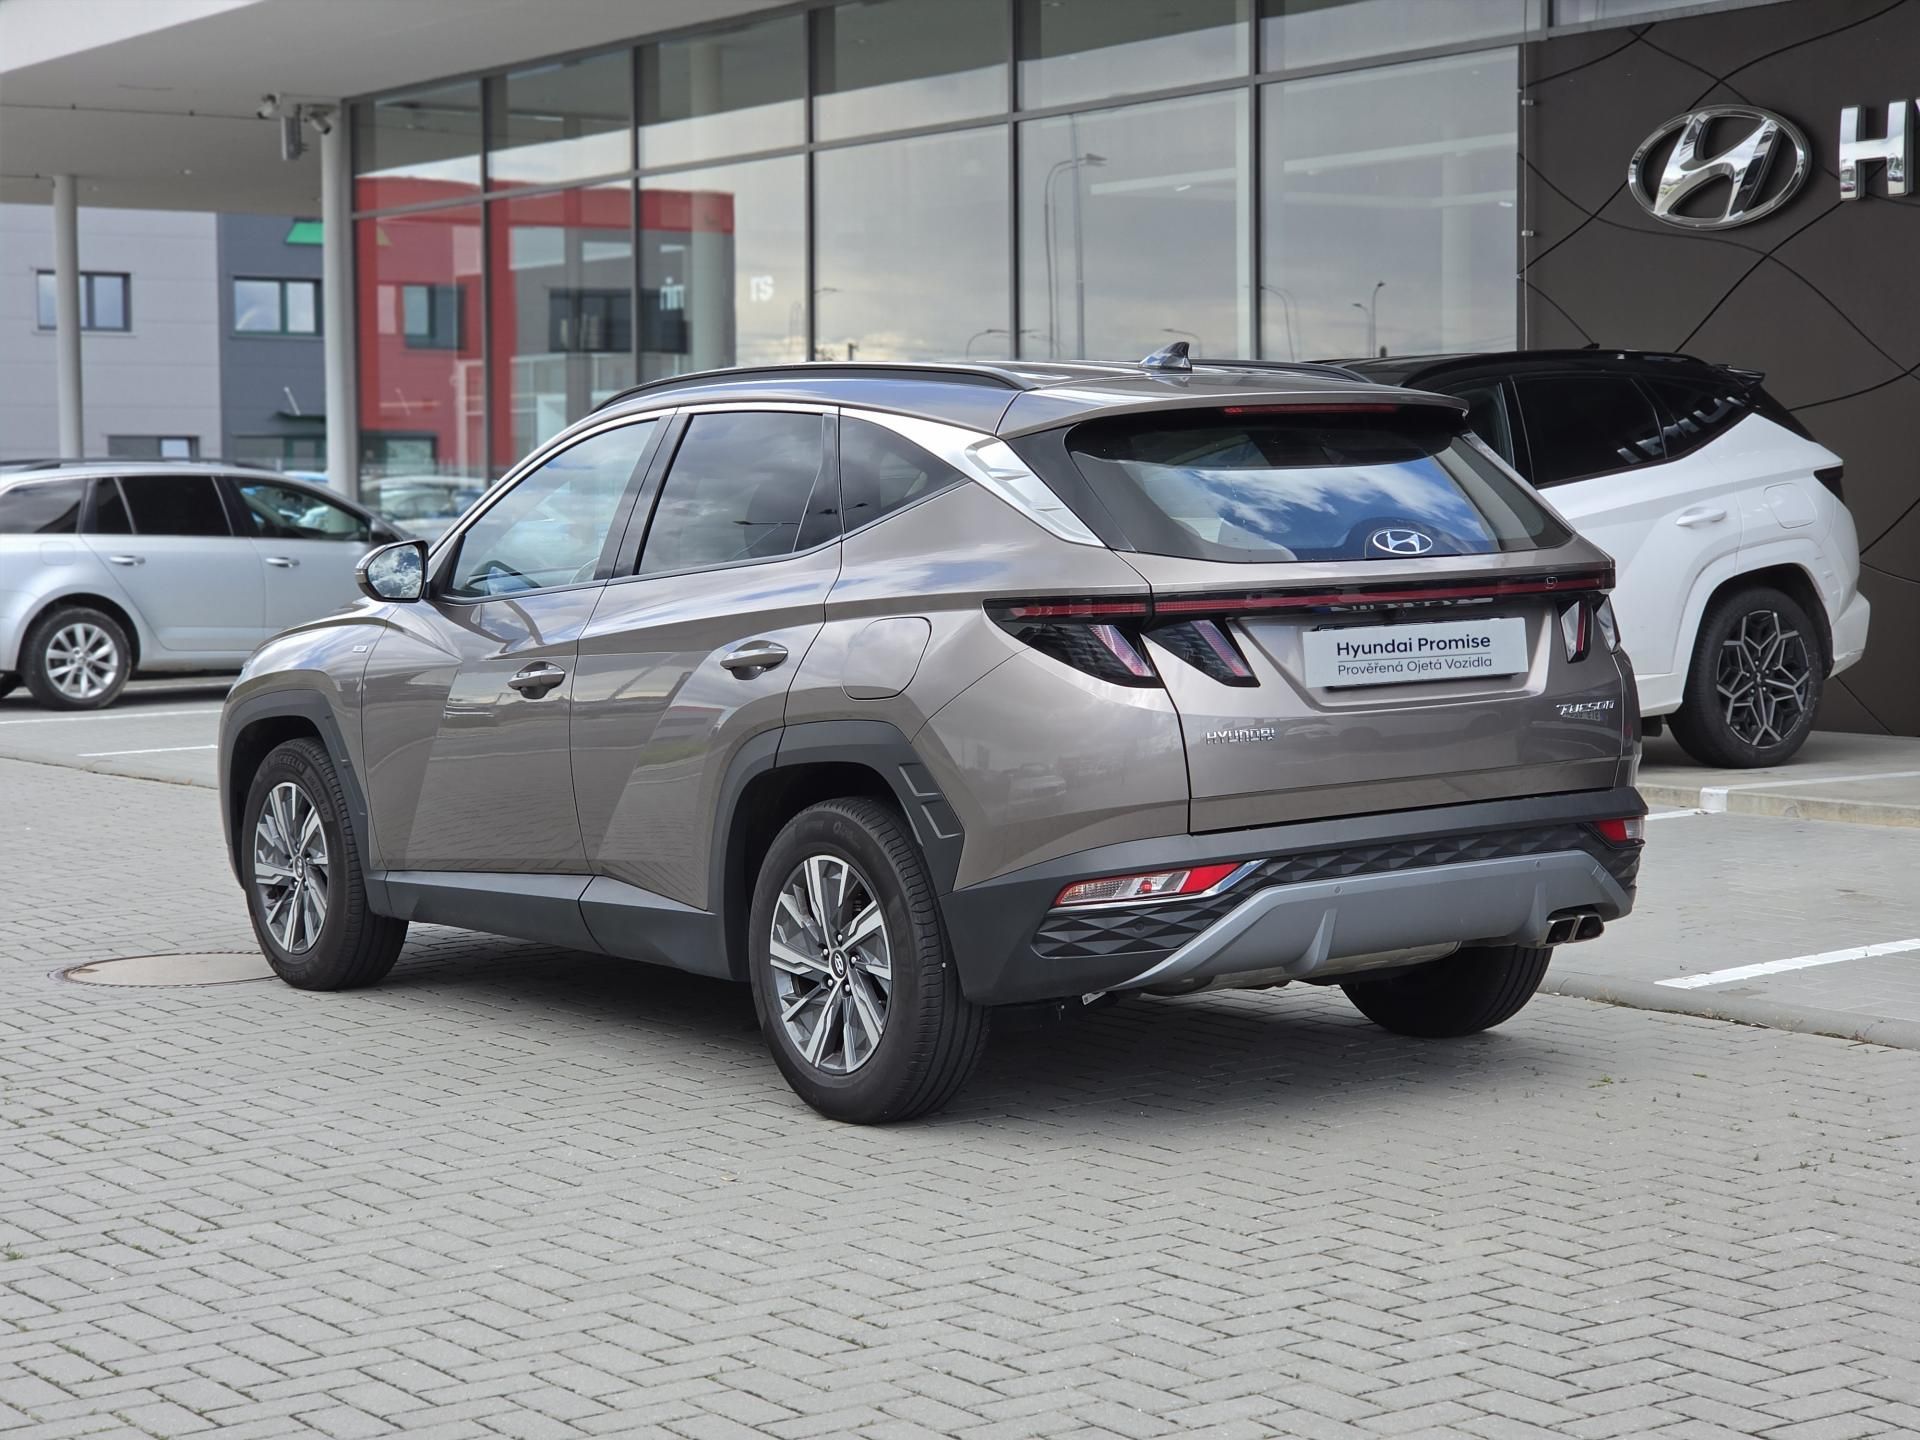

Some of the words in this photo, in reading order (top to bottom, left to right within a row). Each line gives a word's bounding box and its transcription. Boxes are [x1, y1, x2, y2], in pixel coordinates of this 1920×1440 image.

[1838, 97, 1920, 200] H
[1336, 637, 1413, 658] Hyundai
[1418, 634, 1491, 652] Promise
[1337, 661, 1404, 676] Prověřená
[1407, 659, 1442, 674] Ojetá
[1444, 656, 1492, 670] Vozidla
[1206, 727, 1275, 745] HYUNDAI
